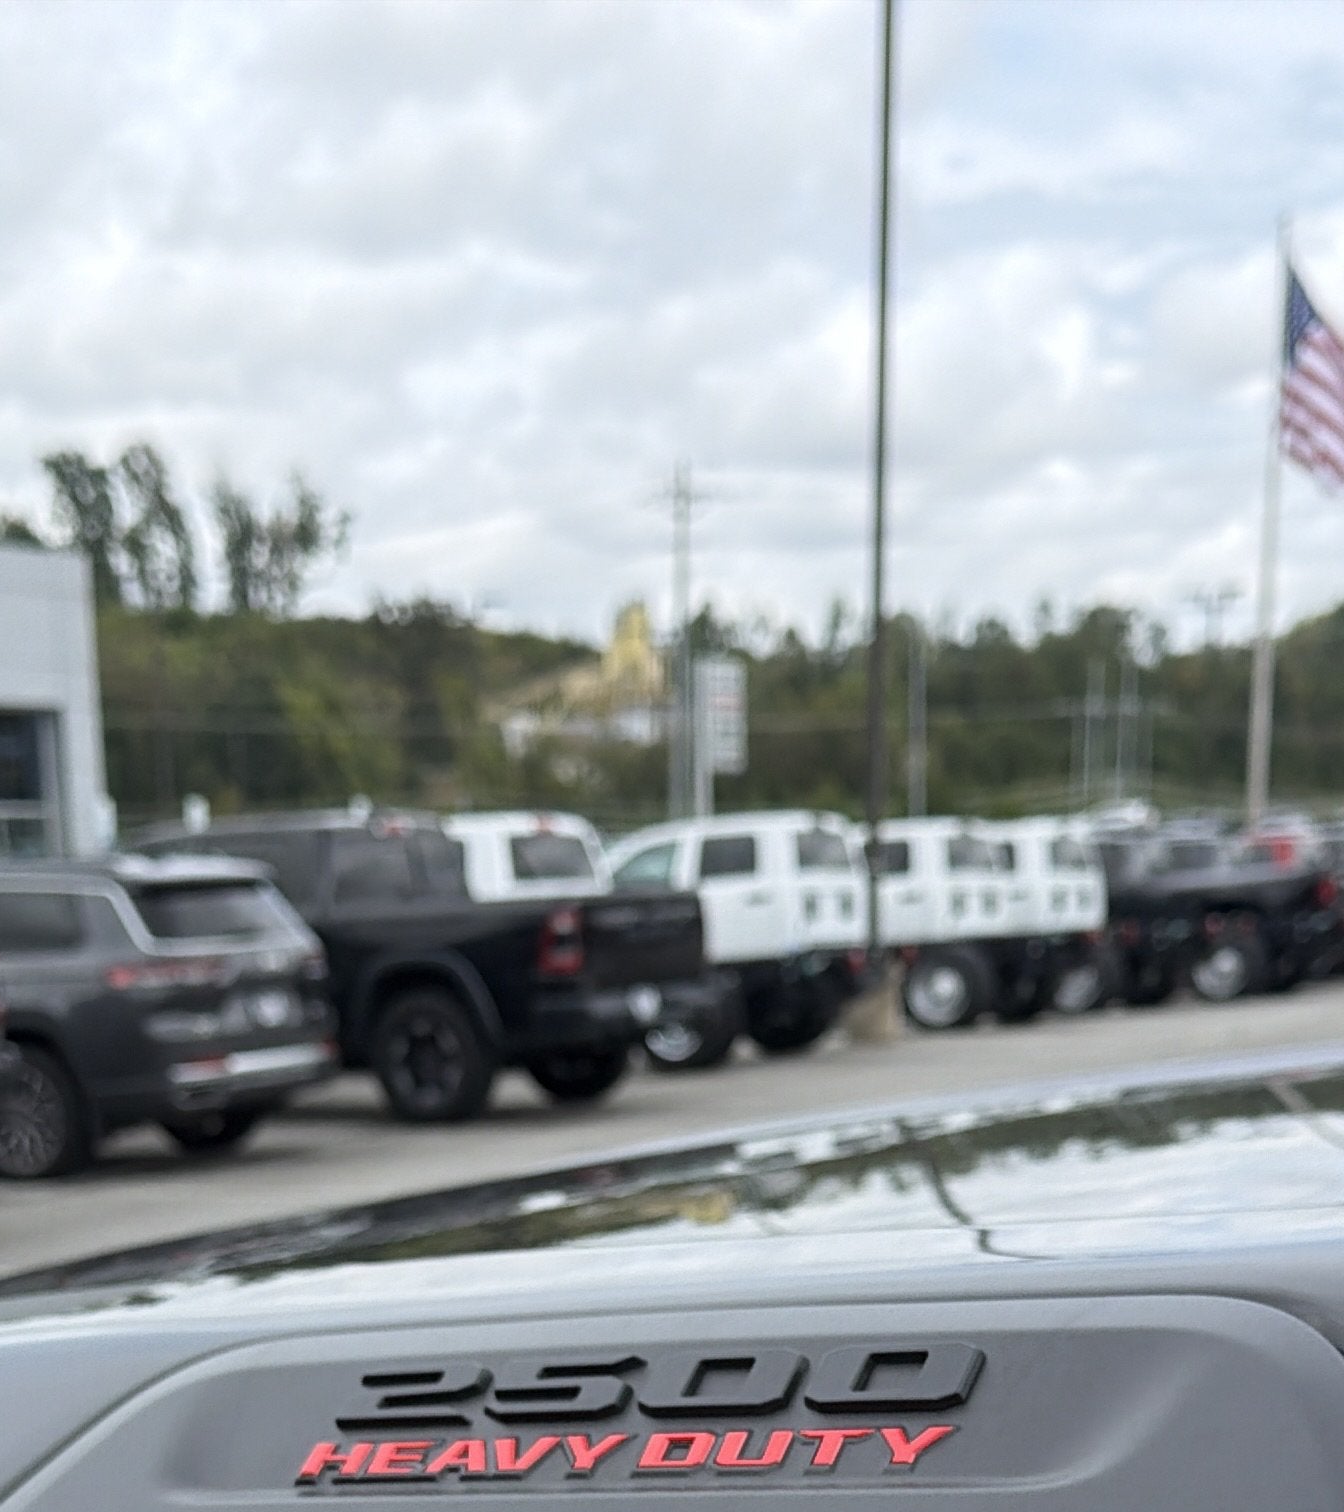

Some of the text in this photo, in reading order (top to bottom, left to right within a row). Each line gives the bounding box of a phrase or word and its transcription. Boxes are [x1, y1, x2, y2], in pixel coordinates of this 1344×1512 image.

[336, 1343, 988, 1430] 2500
[294, 1424, 956, 1485] HEAVY DUTY
